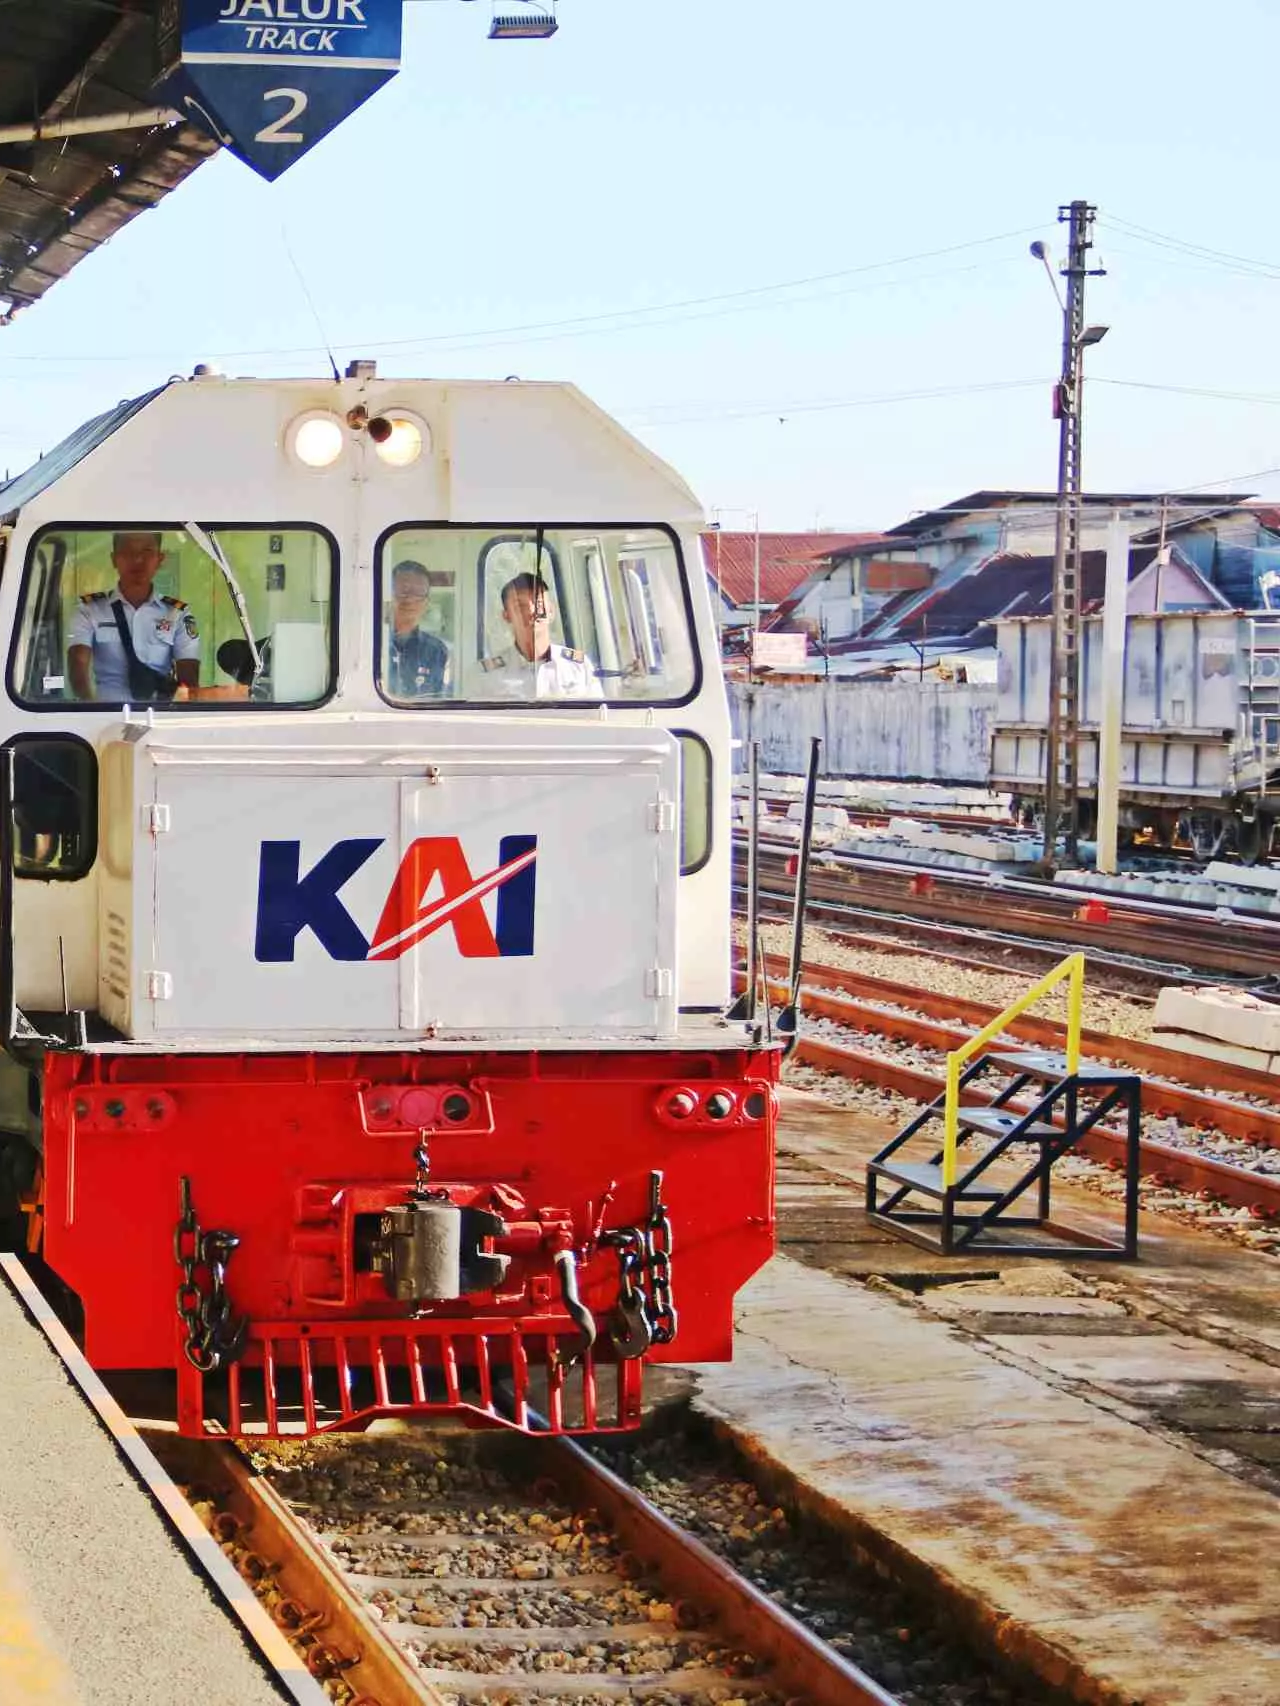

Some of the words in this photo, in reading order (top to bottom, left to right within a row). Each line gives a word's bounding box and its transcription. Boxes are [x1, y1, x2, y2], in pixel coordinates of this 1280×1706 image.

[245, 27, 339, 51] TRACK
[254, 88, 308, 143] 2
[254, 834, 537, 962] KAI
